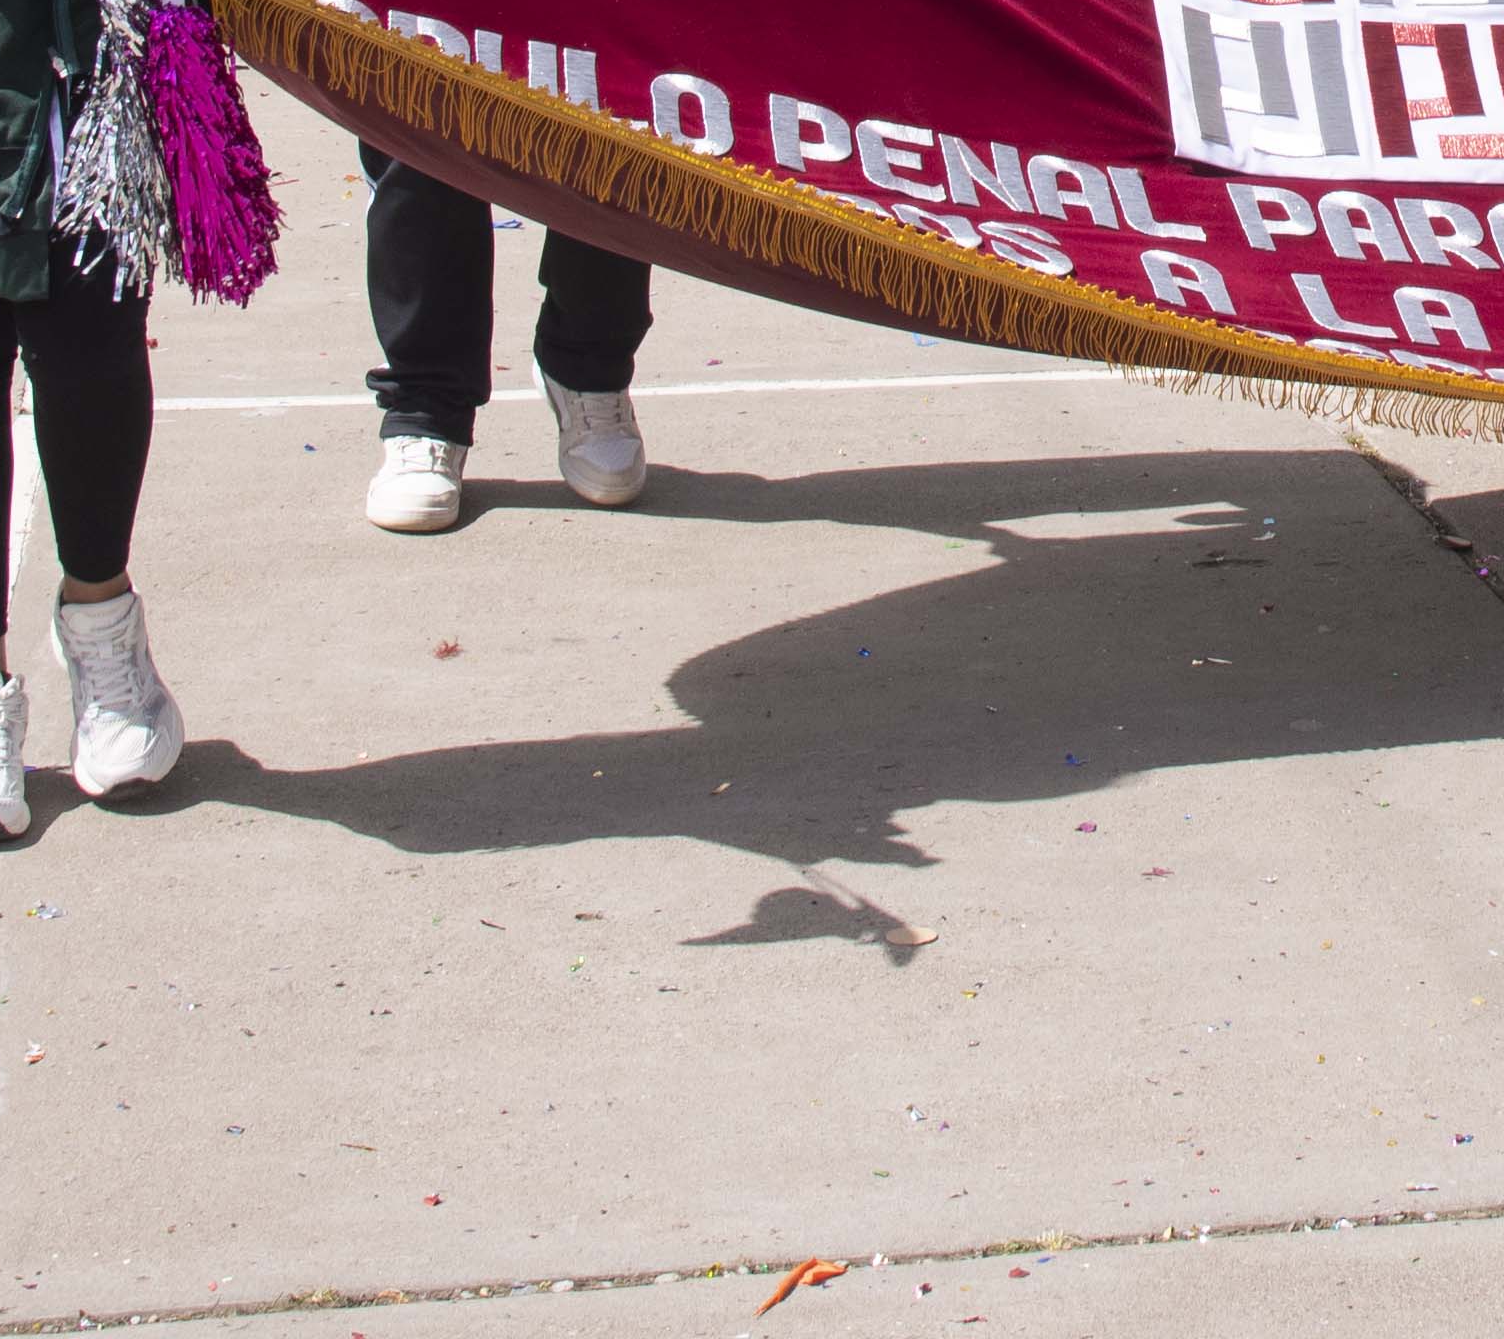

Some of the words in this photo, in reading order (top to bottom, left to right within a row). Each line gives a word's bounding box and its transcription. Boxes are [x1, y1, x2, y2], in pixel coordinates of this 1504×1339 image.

[769, 92, 1207, 243] PENAL
[1139, 249, 1238, 316] A
[1290, 273, 1492, 352] LA
